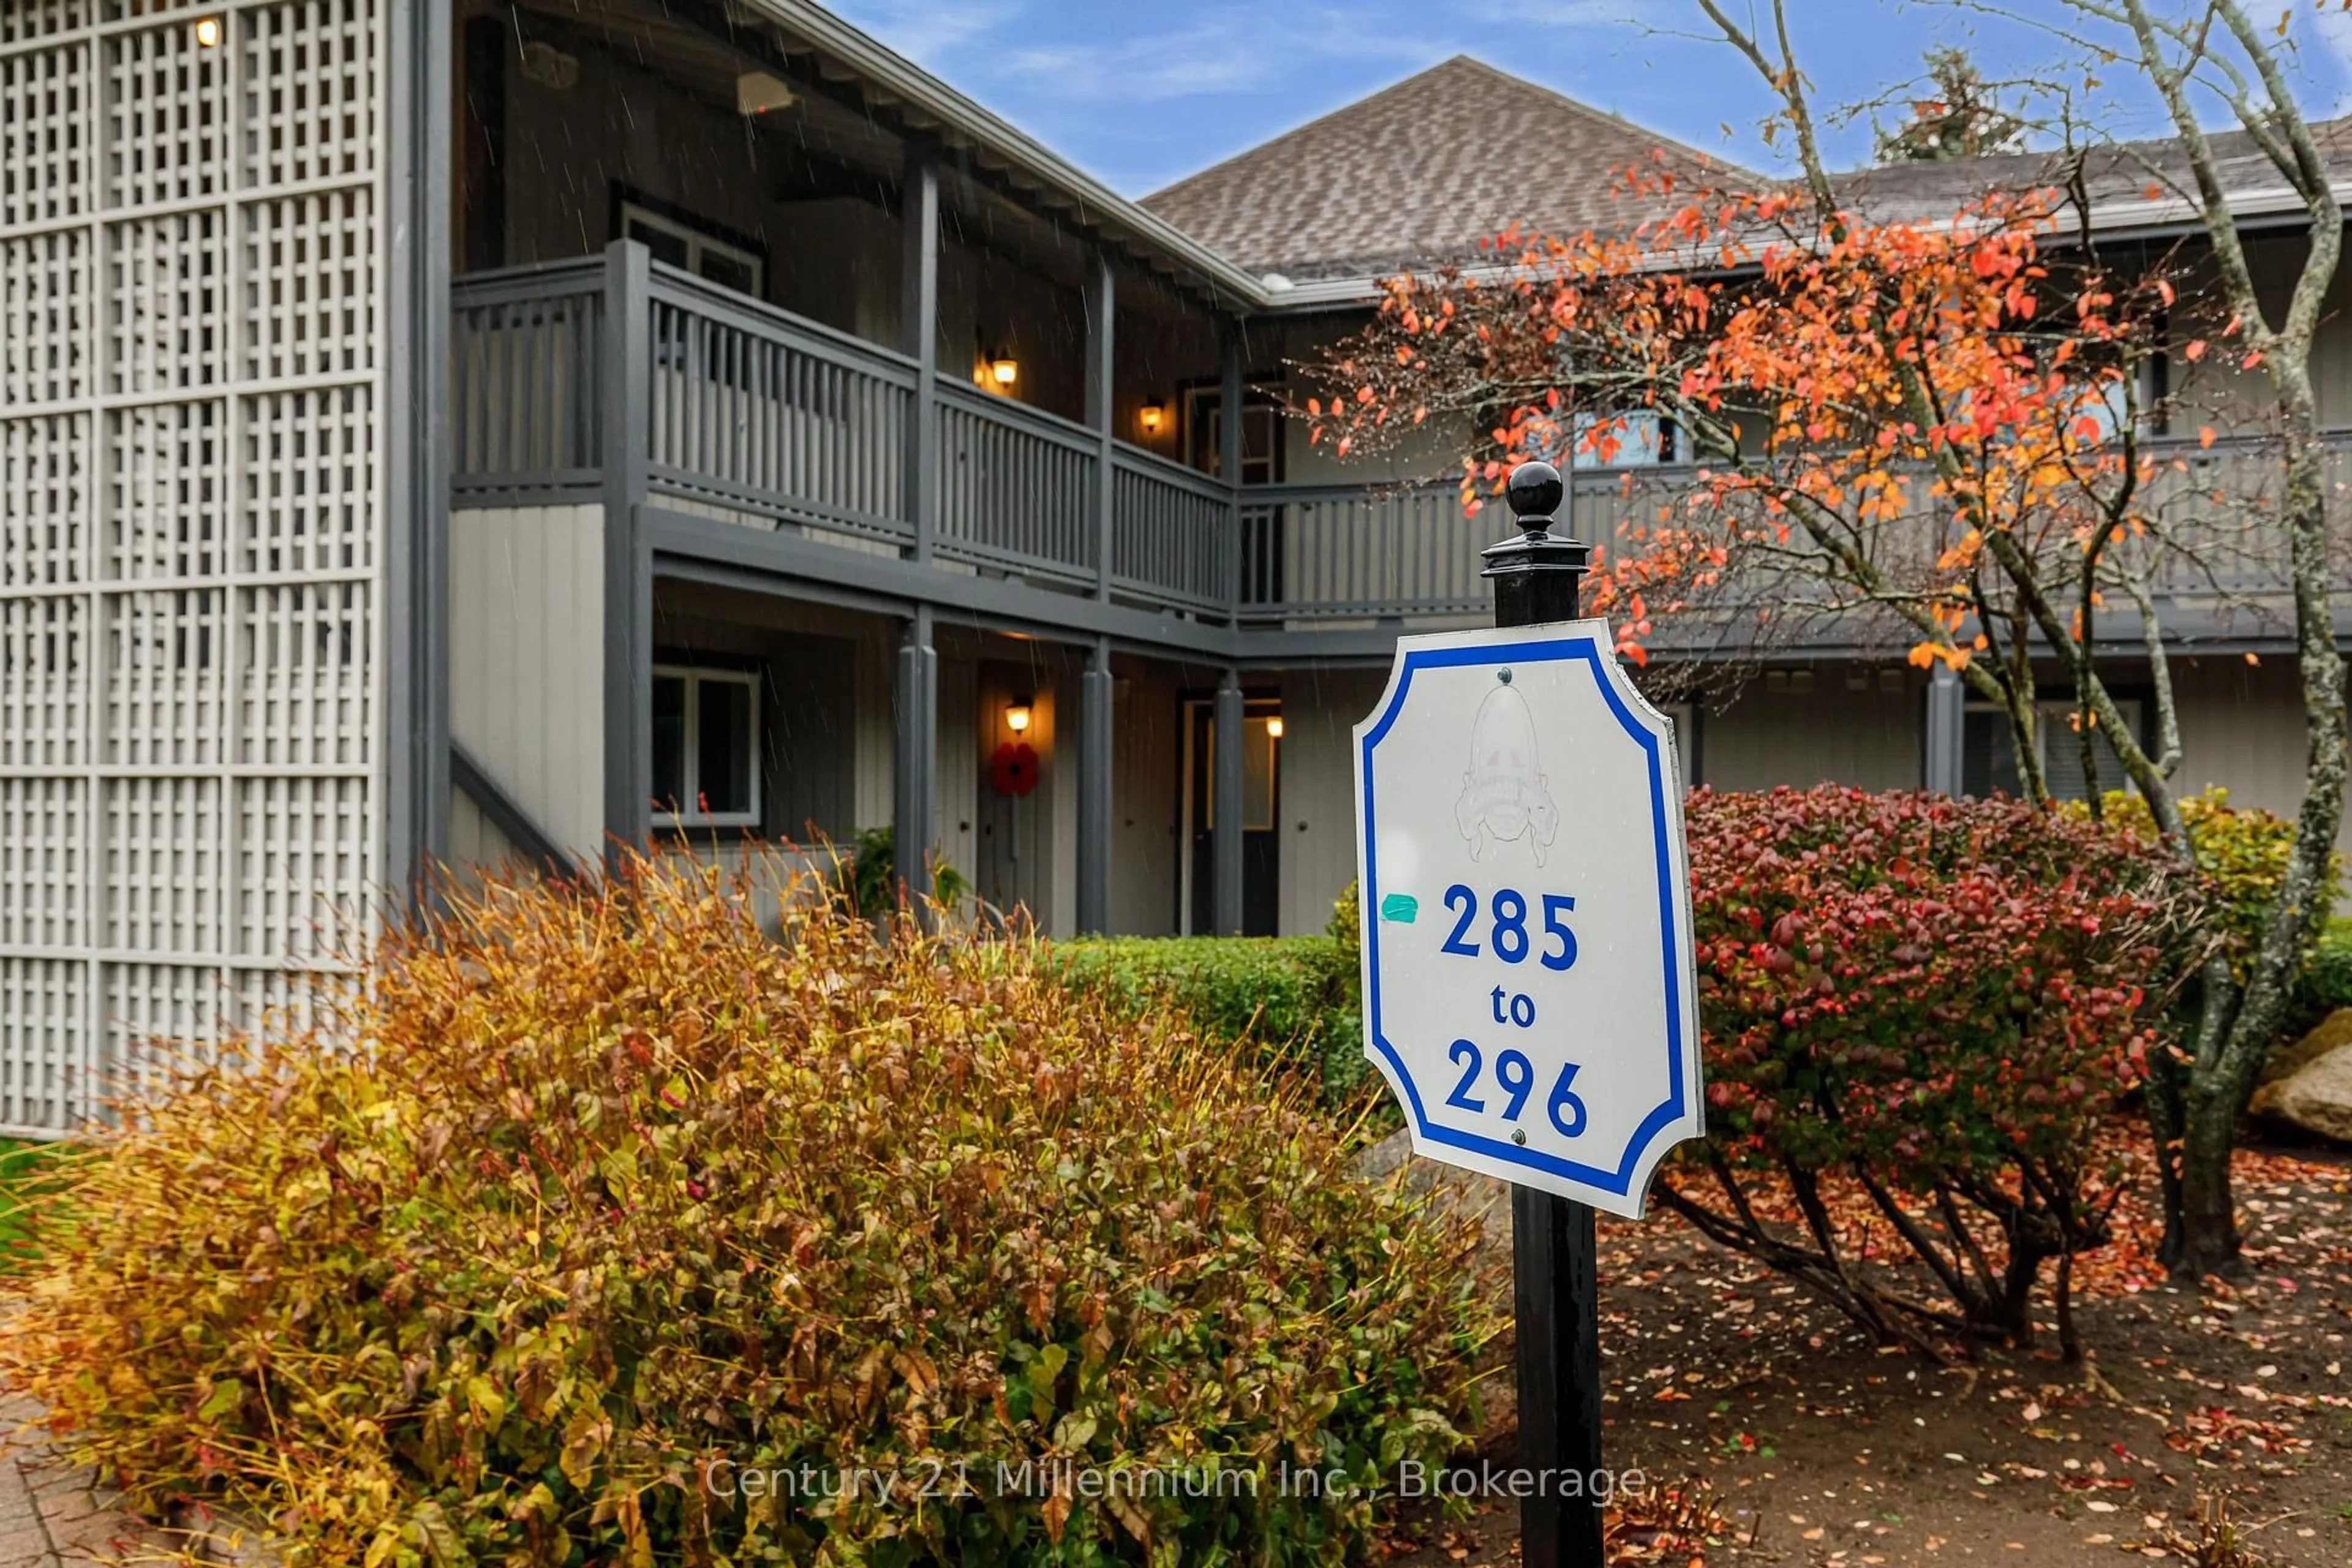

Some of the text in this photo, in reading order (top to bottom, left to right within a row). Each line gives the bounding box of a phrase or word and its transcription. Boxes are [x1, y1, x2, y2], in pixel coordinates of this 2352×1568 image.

[1441, 884, 1578, 971] 285
[1490, 985, 1536, 1028] to
[1446, 1039, 1587, 1138] 296
